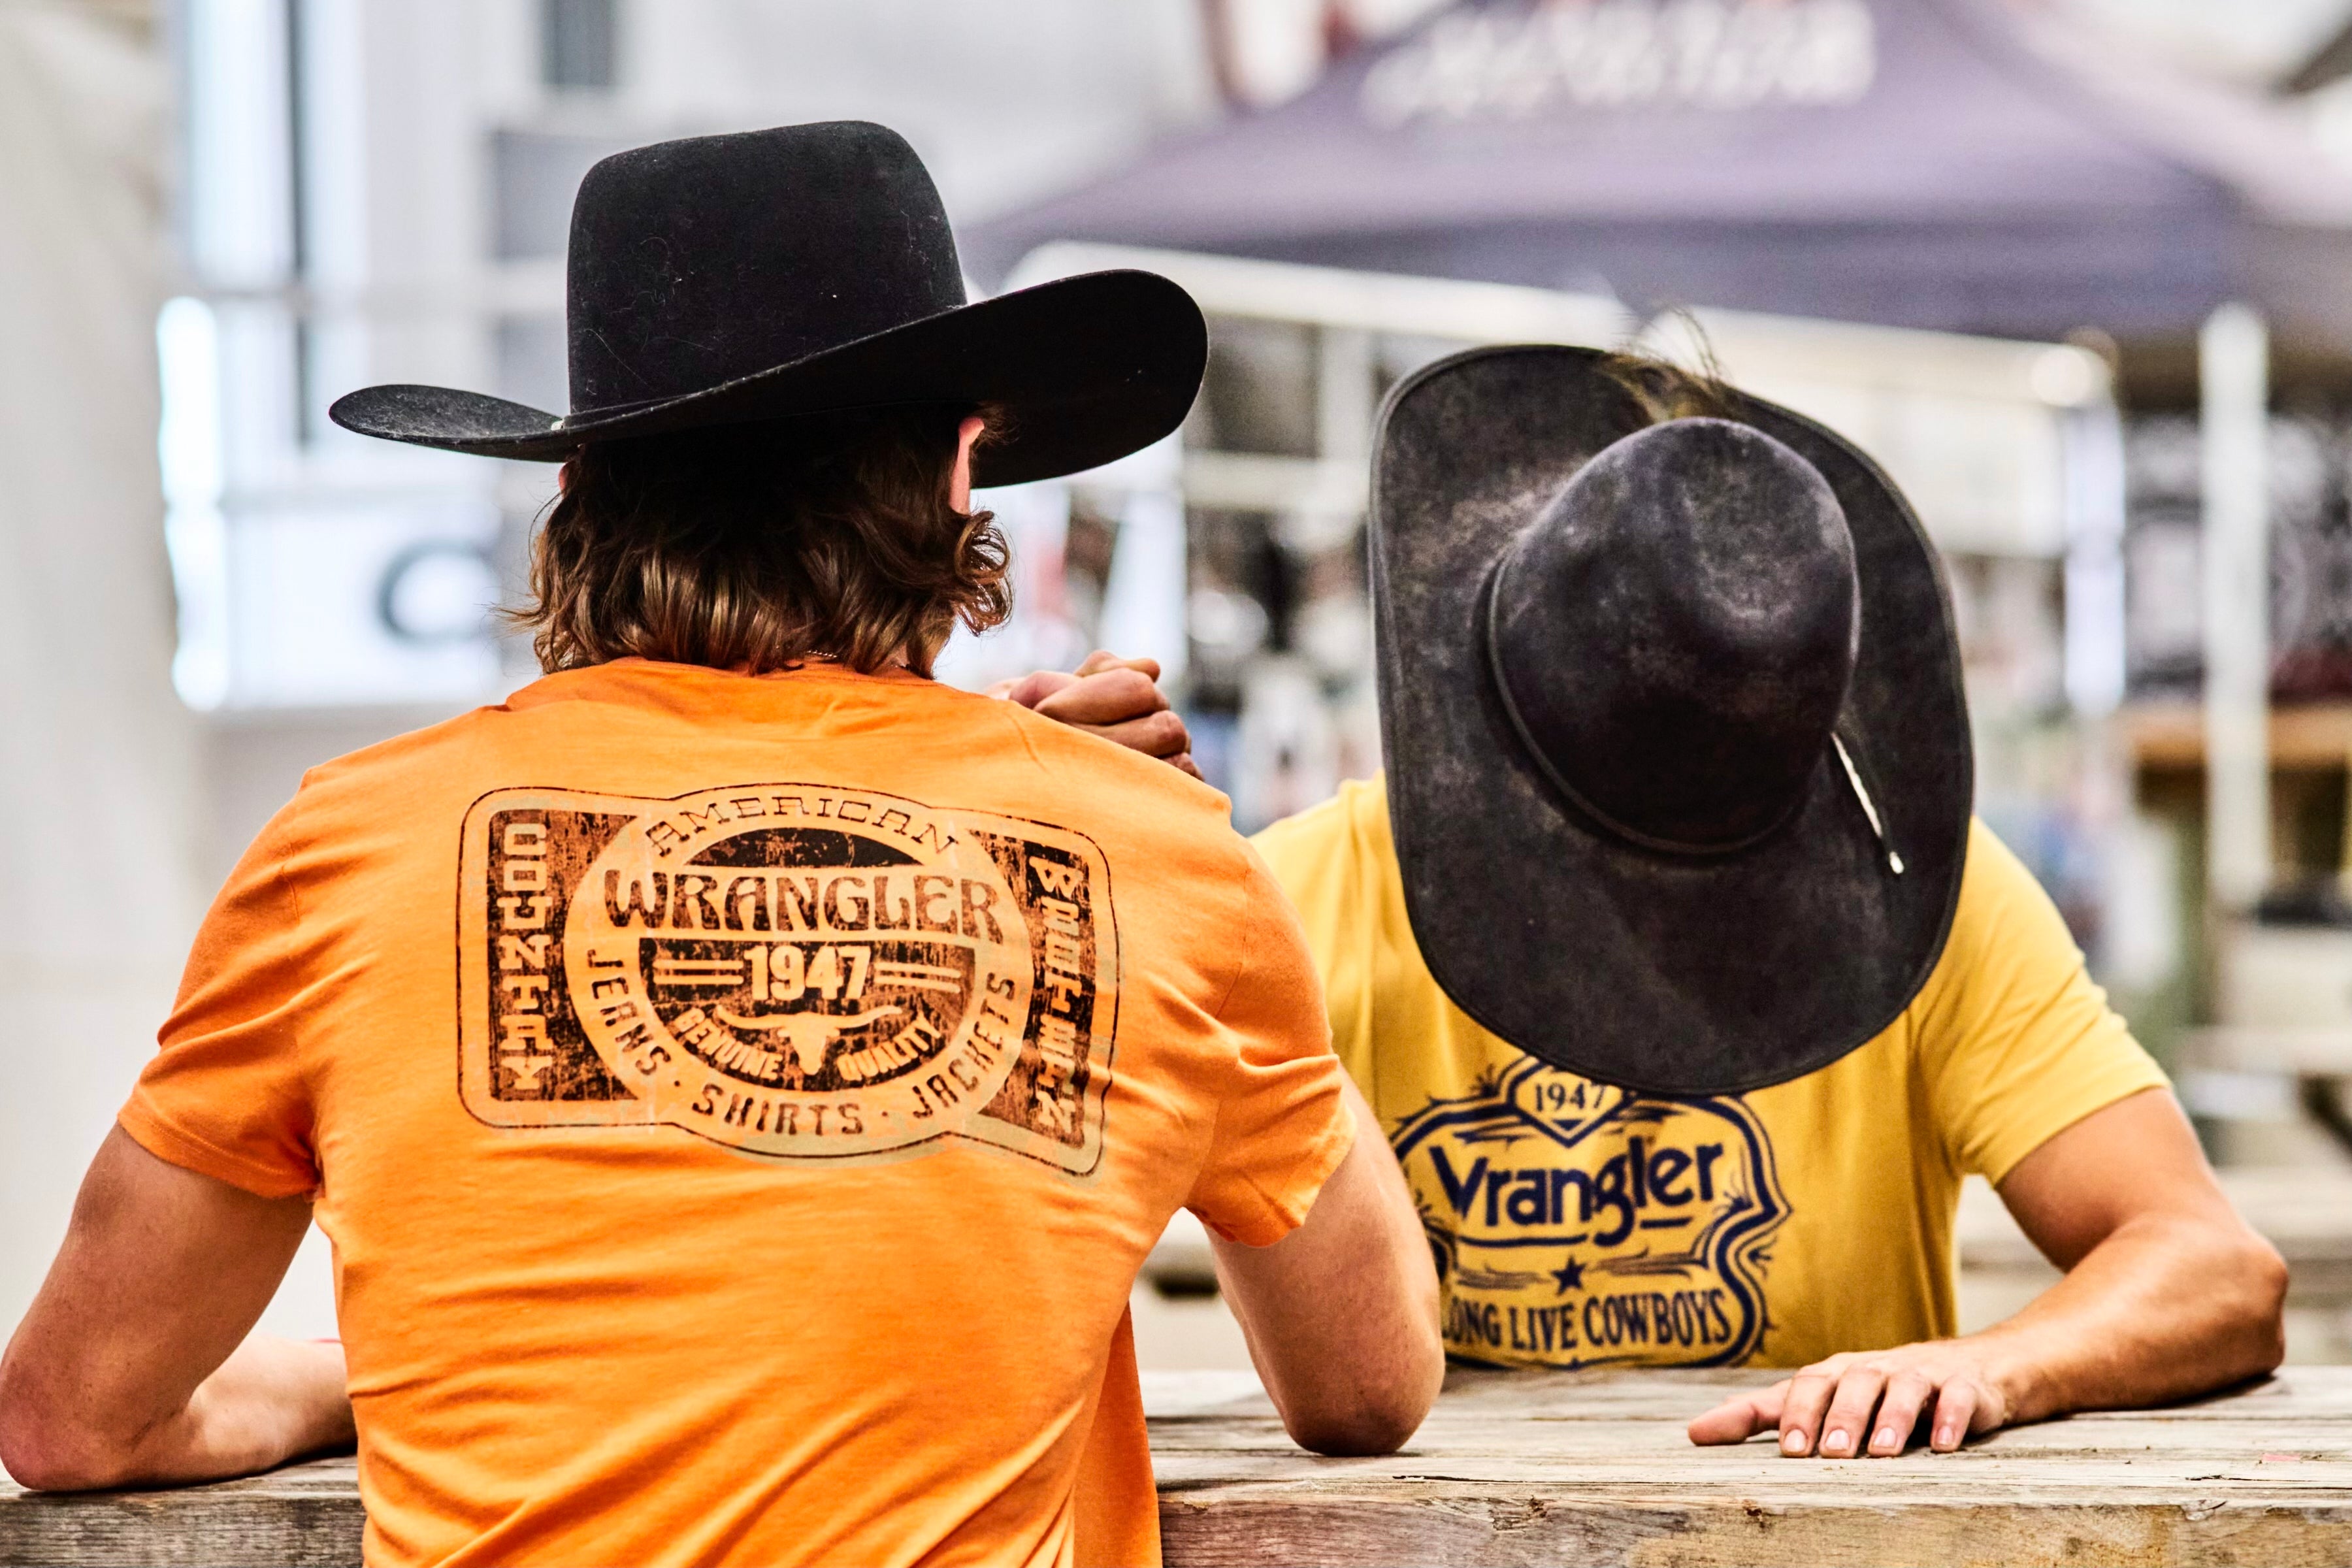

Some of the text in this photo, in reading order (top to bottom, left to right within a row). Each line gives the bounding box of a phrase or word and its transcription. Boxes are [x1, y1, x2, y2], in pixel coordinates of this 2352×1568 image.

[644, 795, 957, 857] AMERICAN
[605, 869, 1004, 945] WRANGLER
[497, 823, 553, 1090] COUNTRY
[743, 945, 872, 1001] 1947
[587, 949, 1016, 1136] JEANS SHIRTS JACKETS
[668, 1007, 942, 1082] GENUINE QUALITY
[1535, 1081, 1607, 1111] 1947
[1509, 1301, 1577, 1352] LIVE
[1582, 1289, 1731, 1346] COWBOYS
